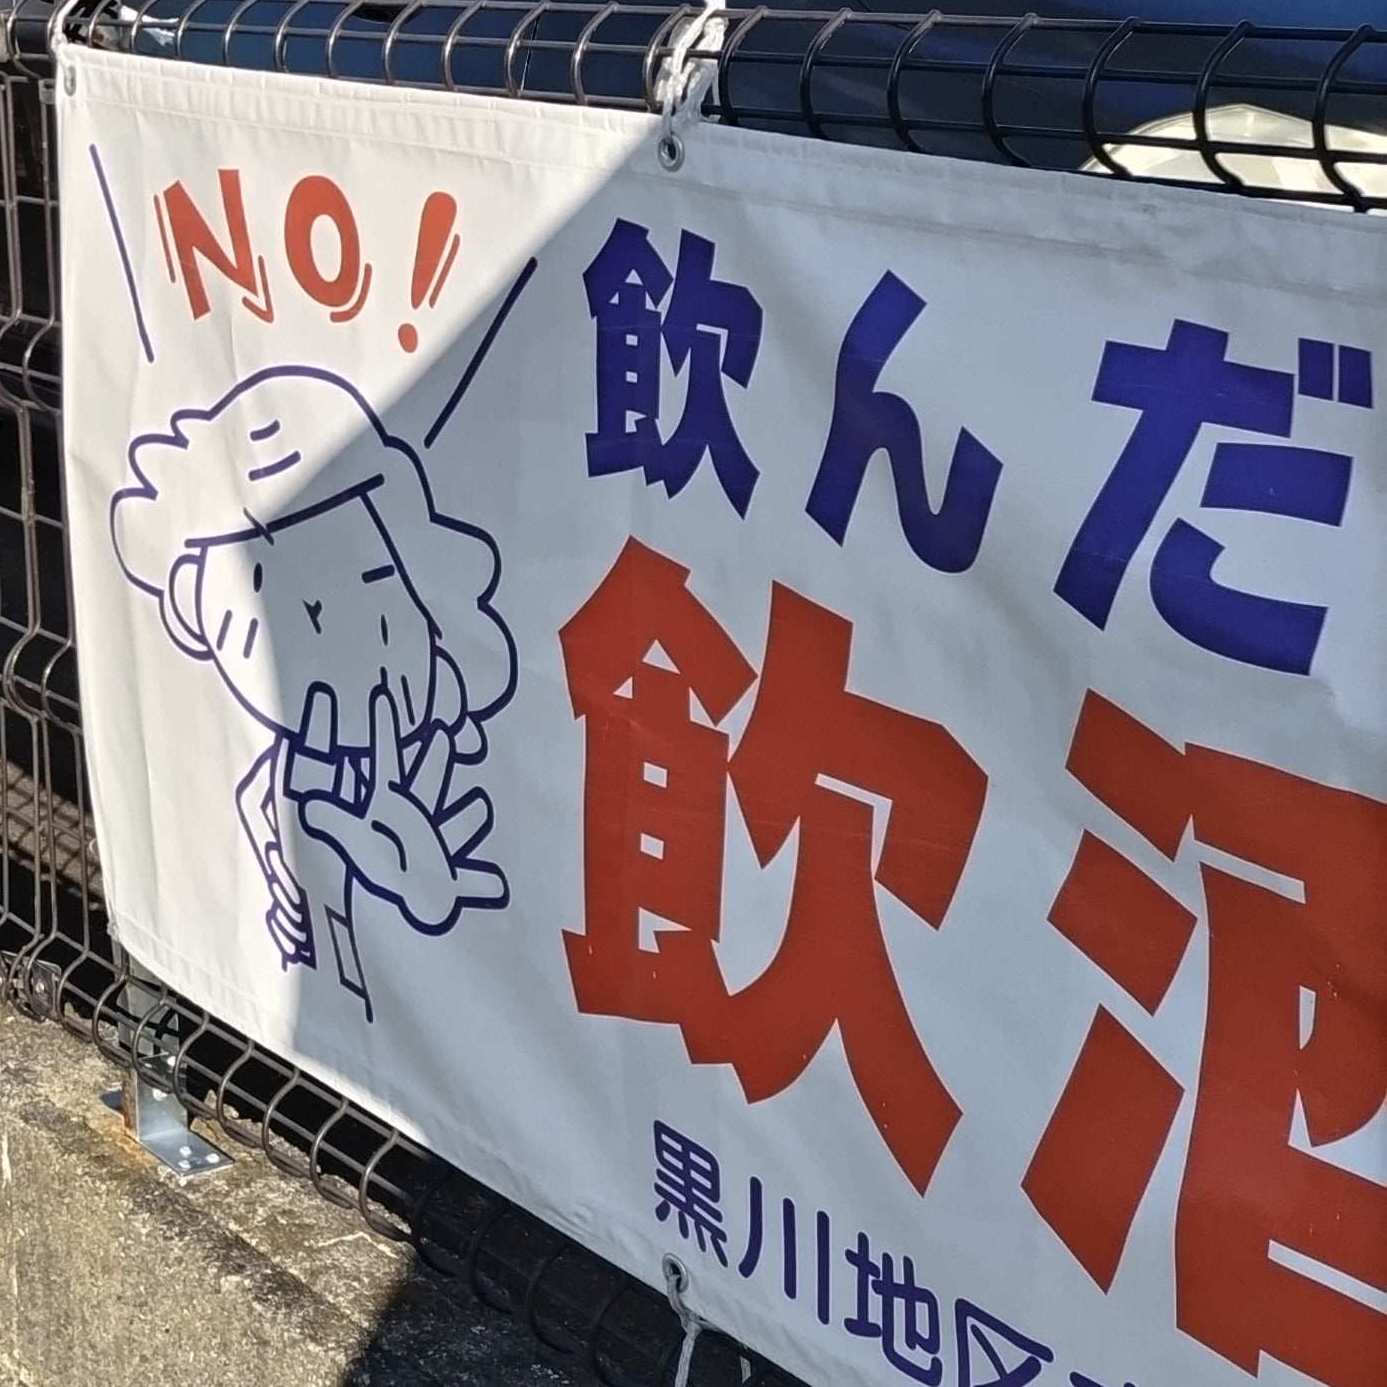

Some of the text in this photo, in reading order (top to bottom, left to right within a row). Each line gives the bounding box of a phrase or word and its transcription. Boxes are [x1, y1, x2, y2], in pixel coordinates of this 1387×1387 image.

[154, 168, 460, 354] NO!
[582, 217, 1375, 676] 飲んだ
[653, 1119, 1138, 1387] 黒川地区
